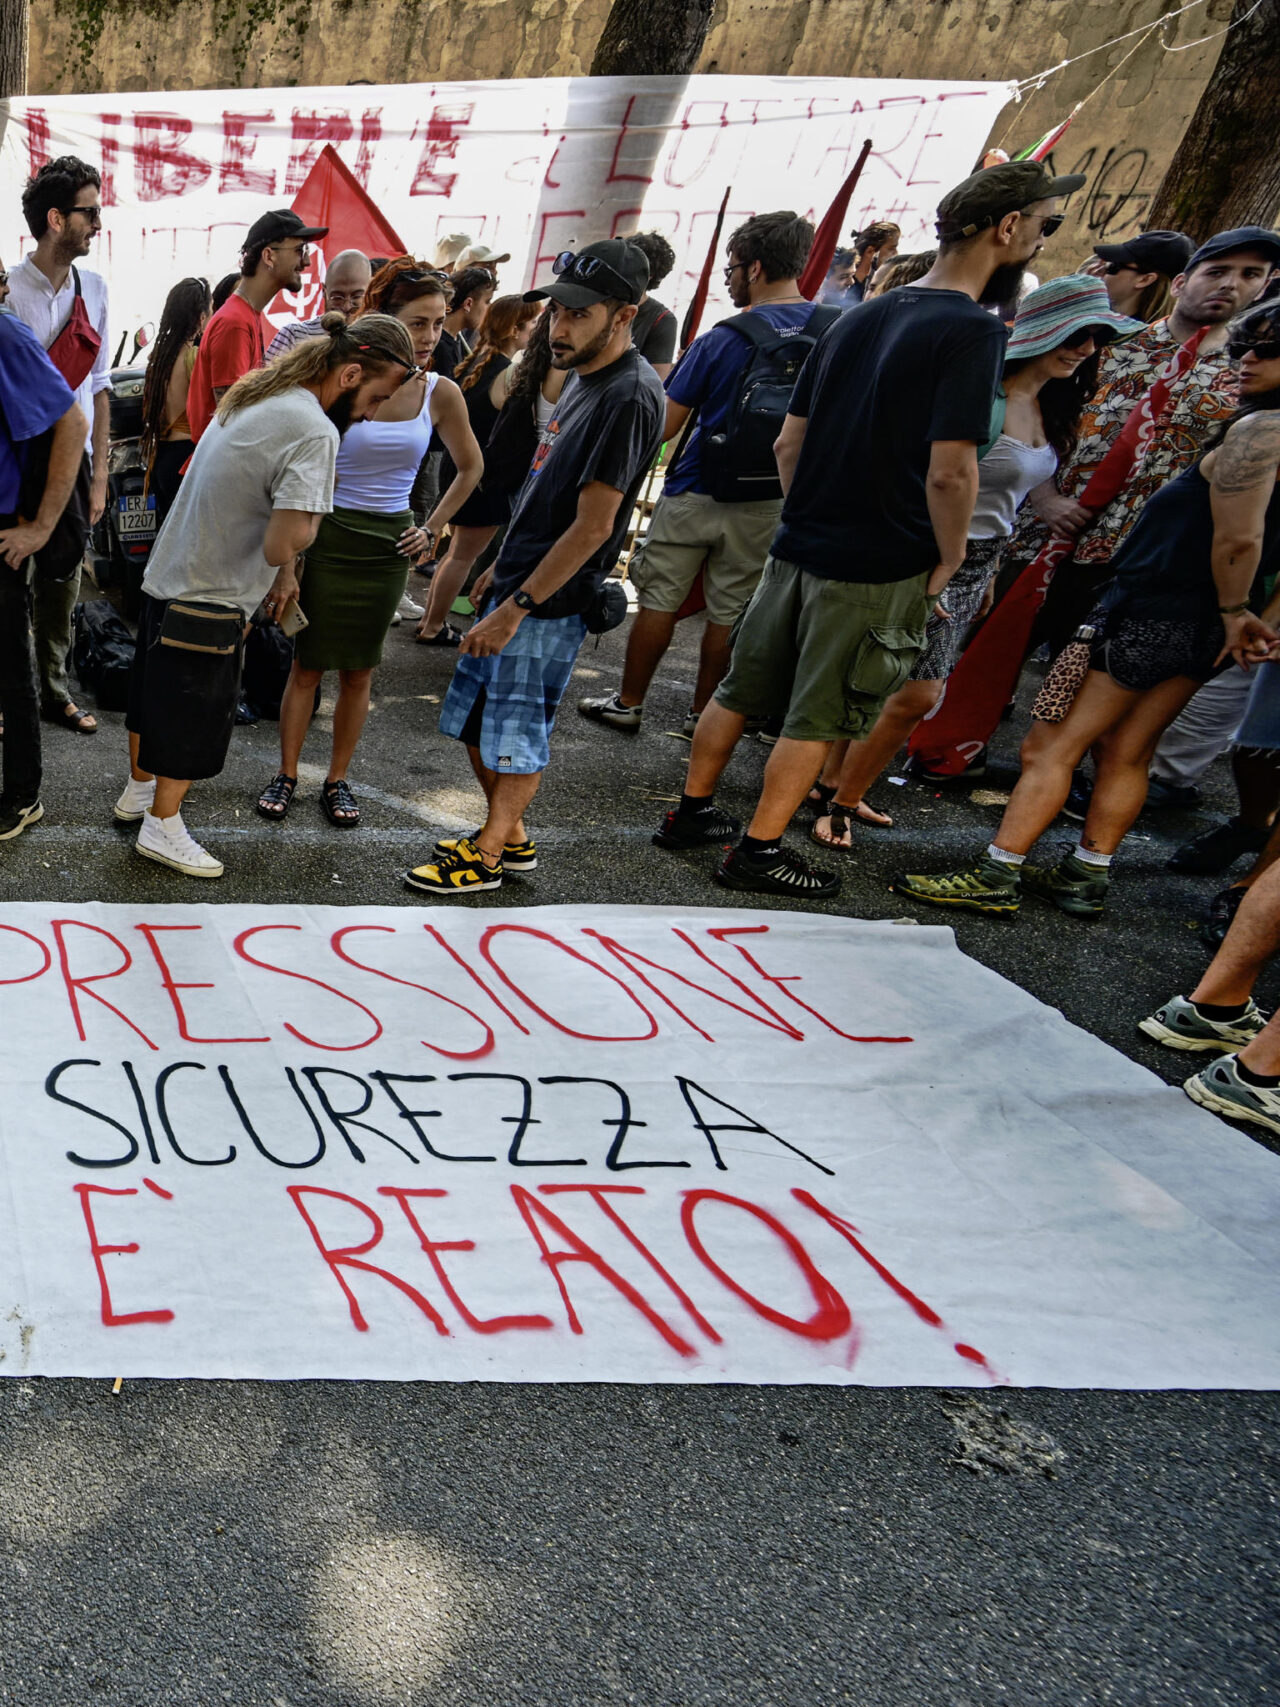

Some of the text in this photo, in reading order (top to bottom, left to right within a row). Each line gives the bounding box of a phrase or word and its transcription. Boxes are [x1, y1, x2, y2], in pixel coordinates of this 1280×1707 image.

[606, 90, 989, 189] LOTTARE
[122, 513, 154, 530] 12207
[127, 496, 141, 512] ER
[45, 1058, 836, 1177] SICUREZZA
[286, 1183, 988, 1366] REATO!
